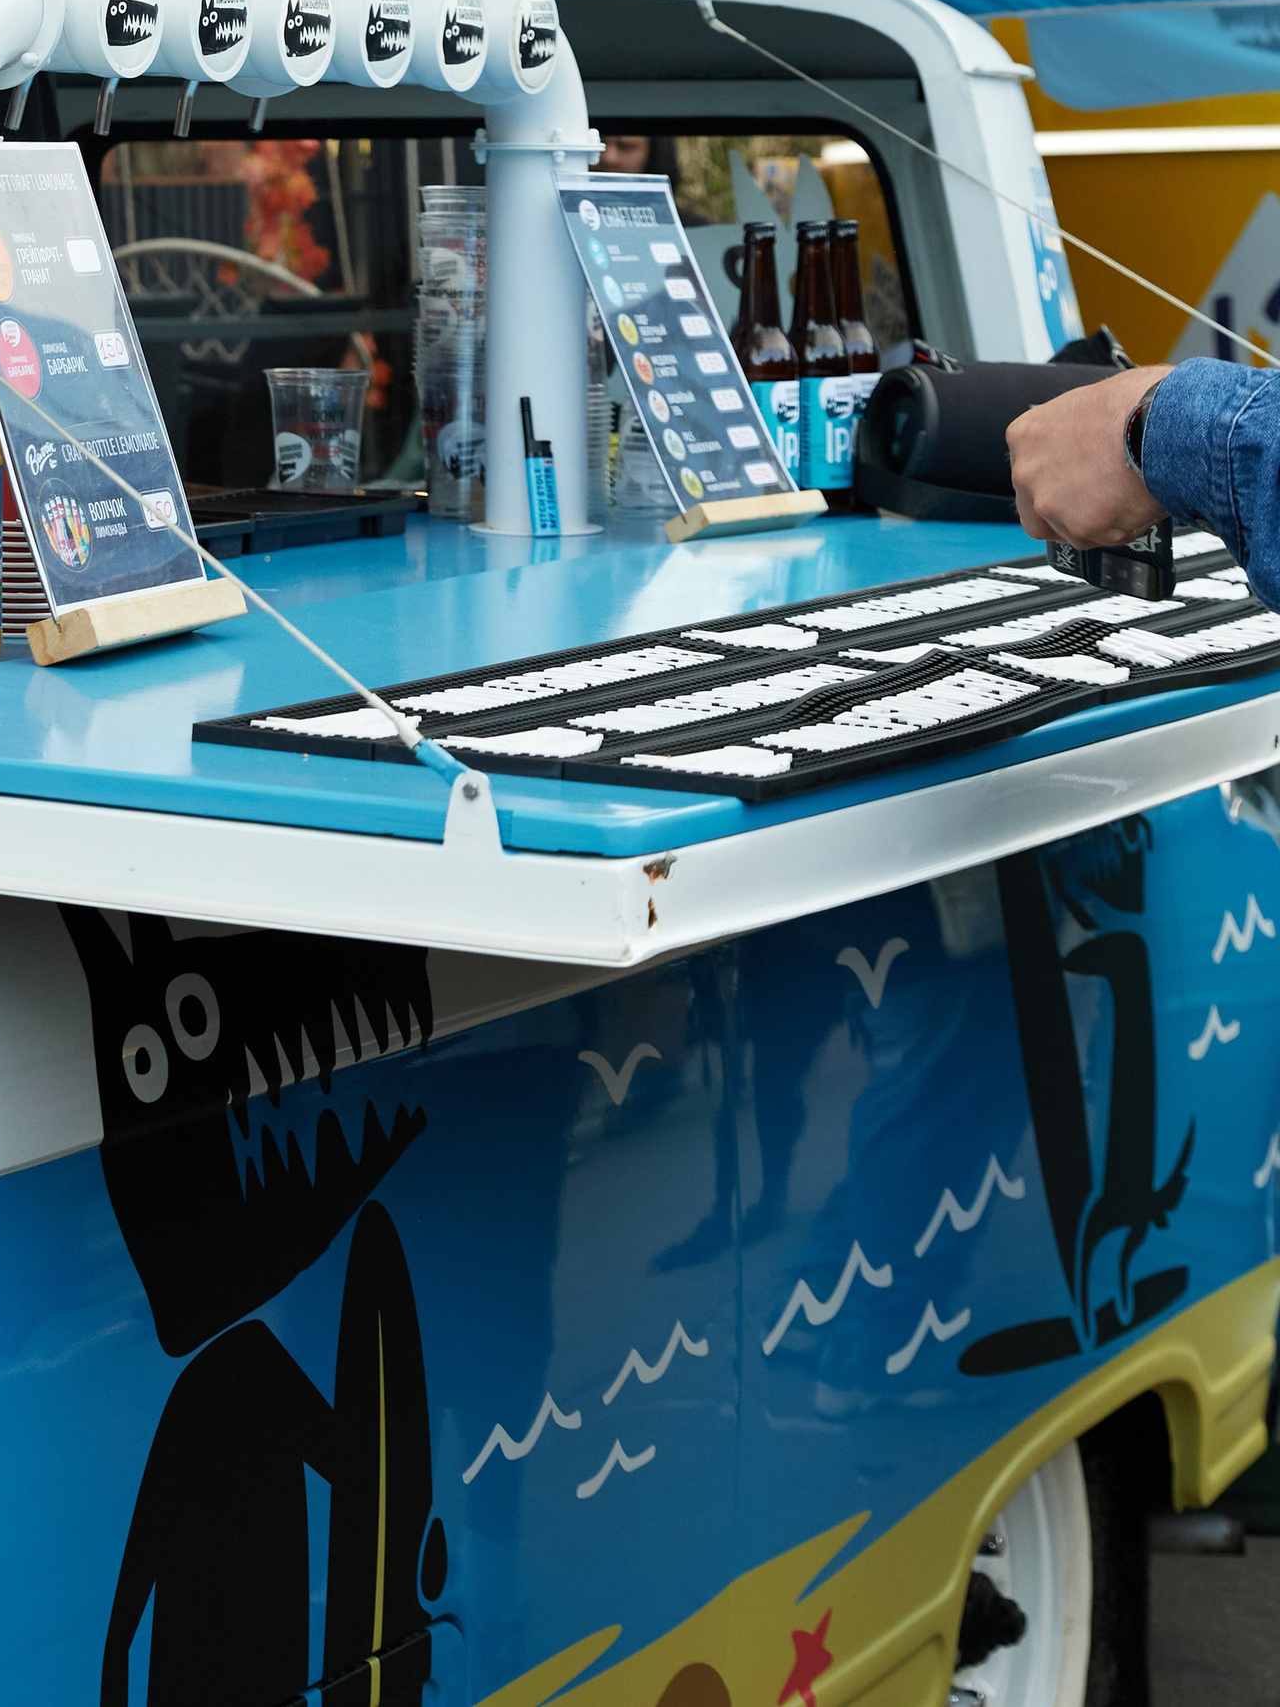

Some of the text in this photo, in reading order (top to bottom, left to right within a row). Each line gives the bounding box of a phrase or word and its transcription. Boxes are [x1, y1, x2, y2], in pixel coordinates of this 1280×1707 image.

[11, 174, 36, 191] DRAFT
[35, 173, 78, 191] LEMONADE
[21, 268, 52, 285] ГРАНАТ
[99, 337, 125, 360] 150
[7, 365, 37, 378] БАРБАРИС
[46, 355, 89, 376] БАРБАРИС
[116, 432, 160, 454] LEMONADE
[88, 497, 127, 522] ВОЛЧОК
[95, 522, 128, 539] ЛИМОНАДЫ
